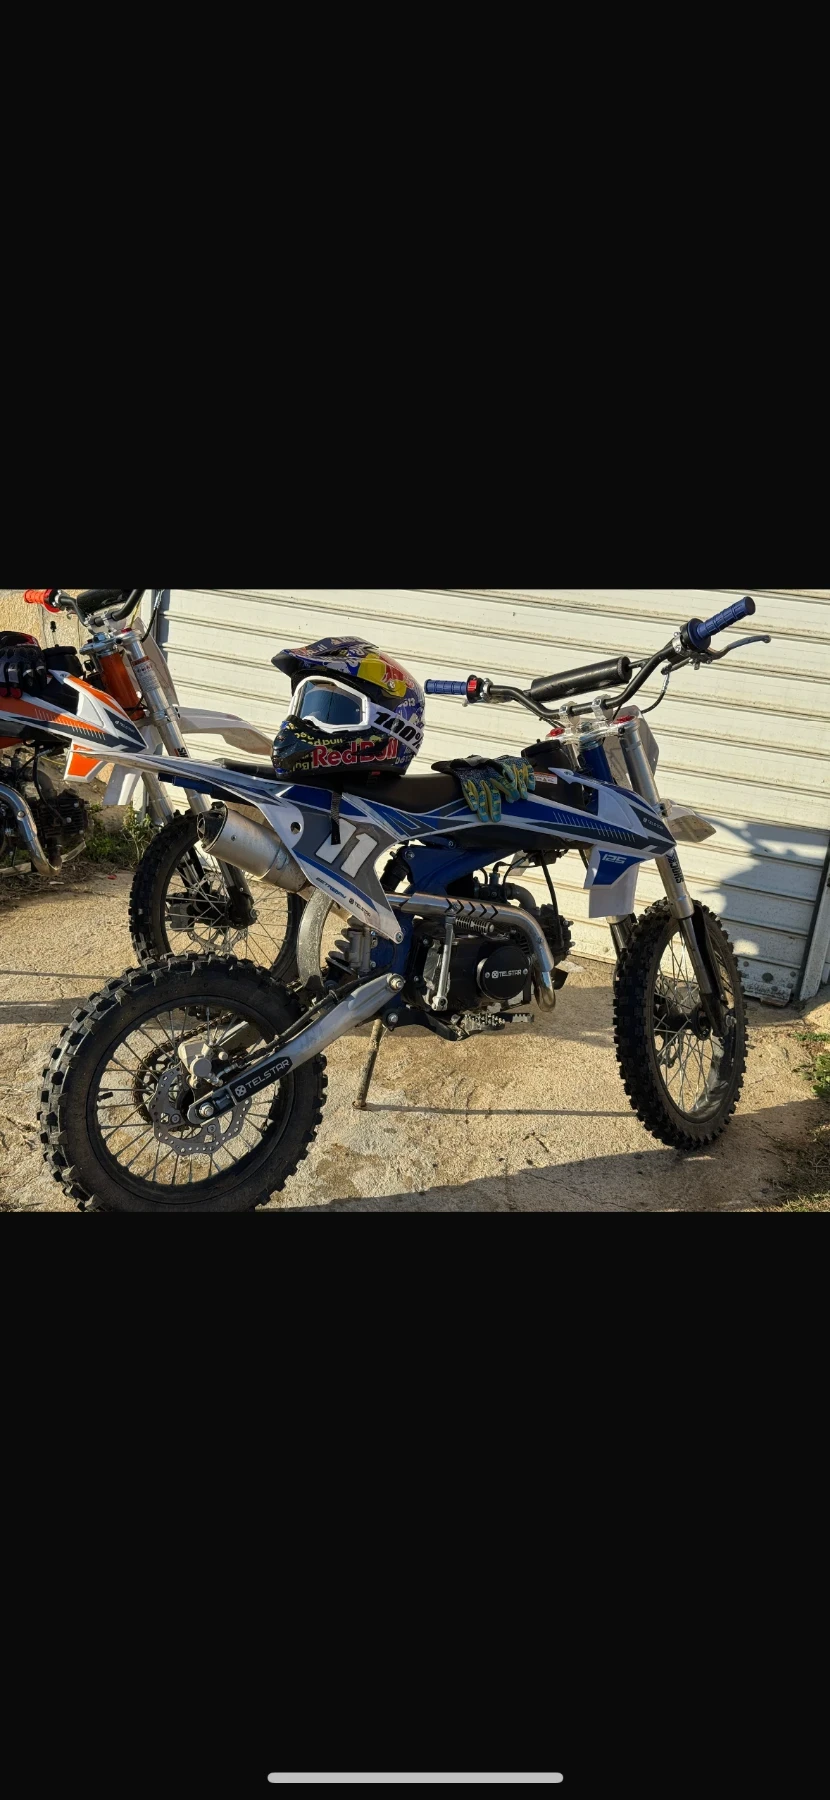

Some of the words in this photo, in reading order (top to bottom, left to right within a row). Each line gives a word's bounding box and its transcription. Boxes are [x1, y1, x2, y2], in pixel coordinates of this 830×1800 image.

[374, 711, 424, 749] 100%
[311, 741, 358, 768] Red
[359, 737, 399, 763] Bull
[602, 854, 627, 864] 125
[499, 970, 522, 978] TELSTAR
[245, 1059, 290, 1089] TELSTAR
